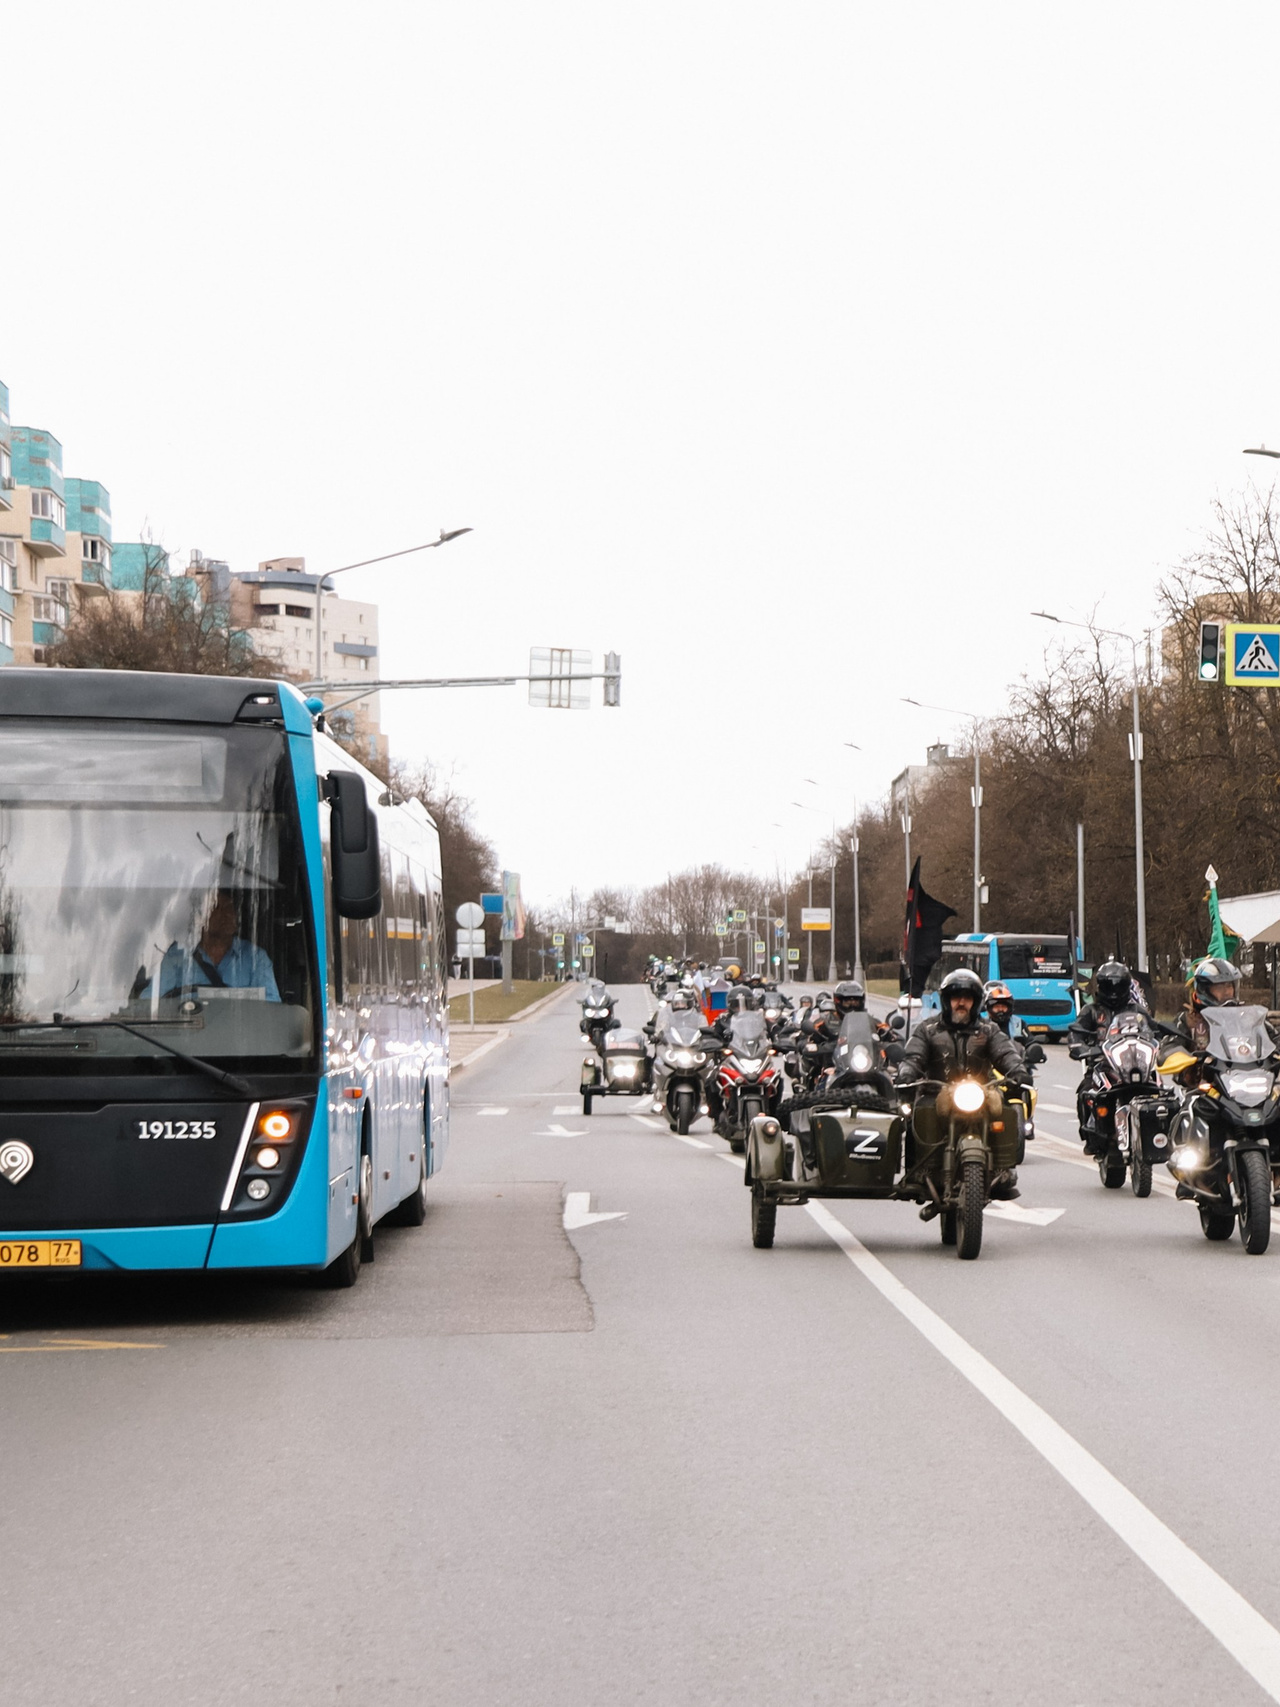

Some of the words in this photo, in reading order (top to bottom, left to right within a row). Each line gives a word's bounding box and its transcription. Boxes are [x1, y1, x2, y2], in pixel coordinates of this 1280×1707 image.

[138, 1121, 217, 1139] 191235
[854, 1129, 880, 1153] Z
[0, 1245, 39, 1263] 078
[53, 1243, 73, 1257] 77
